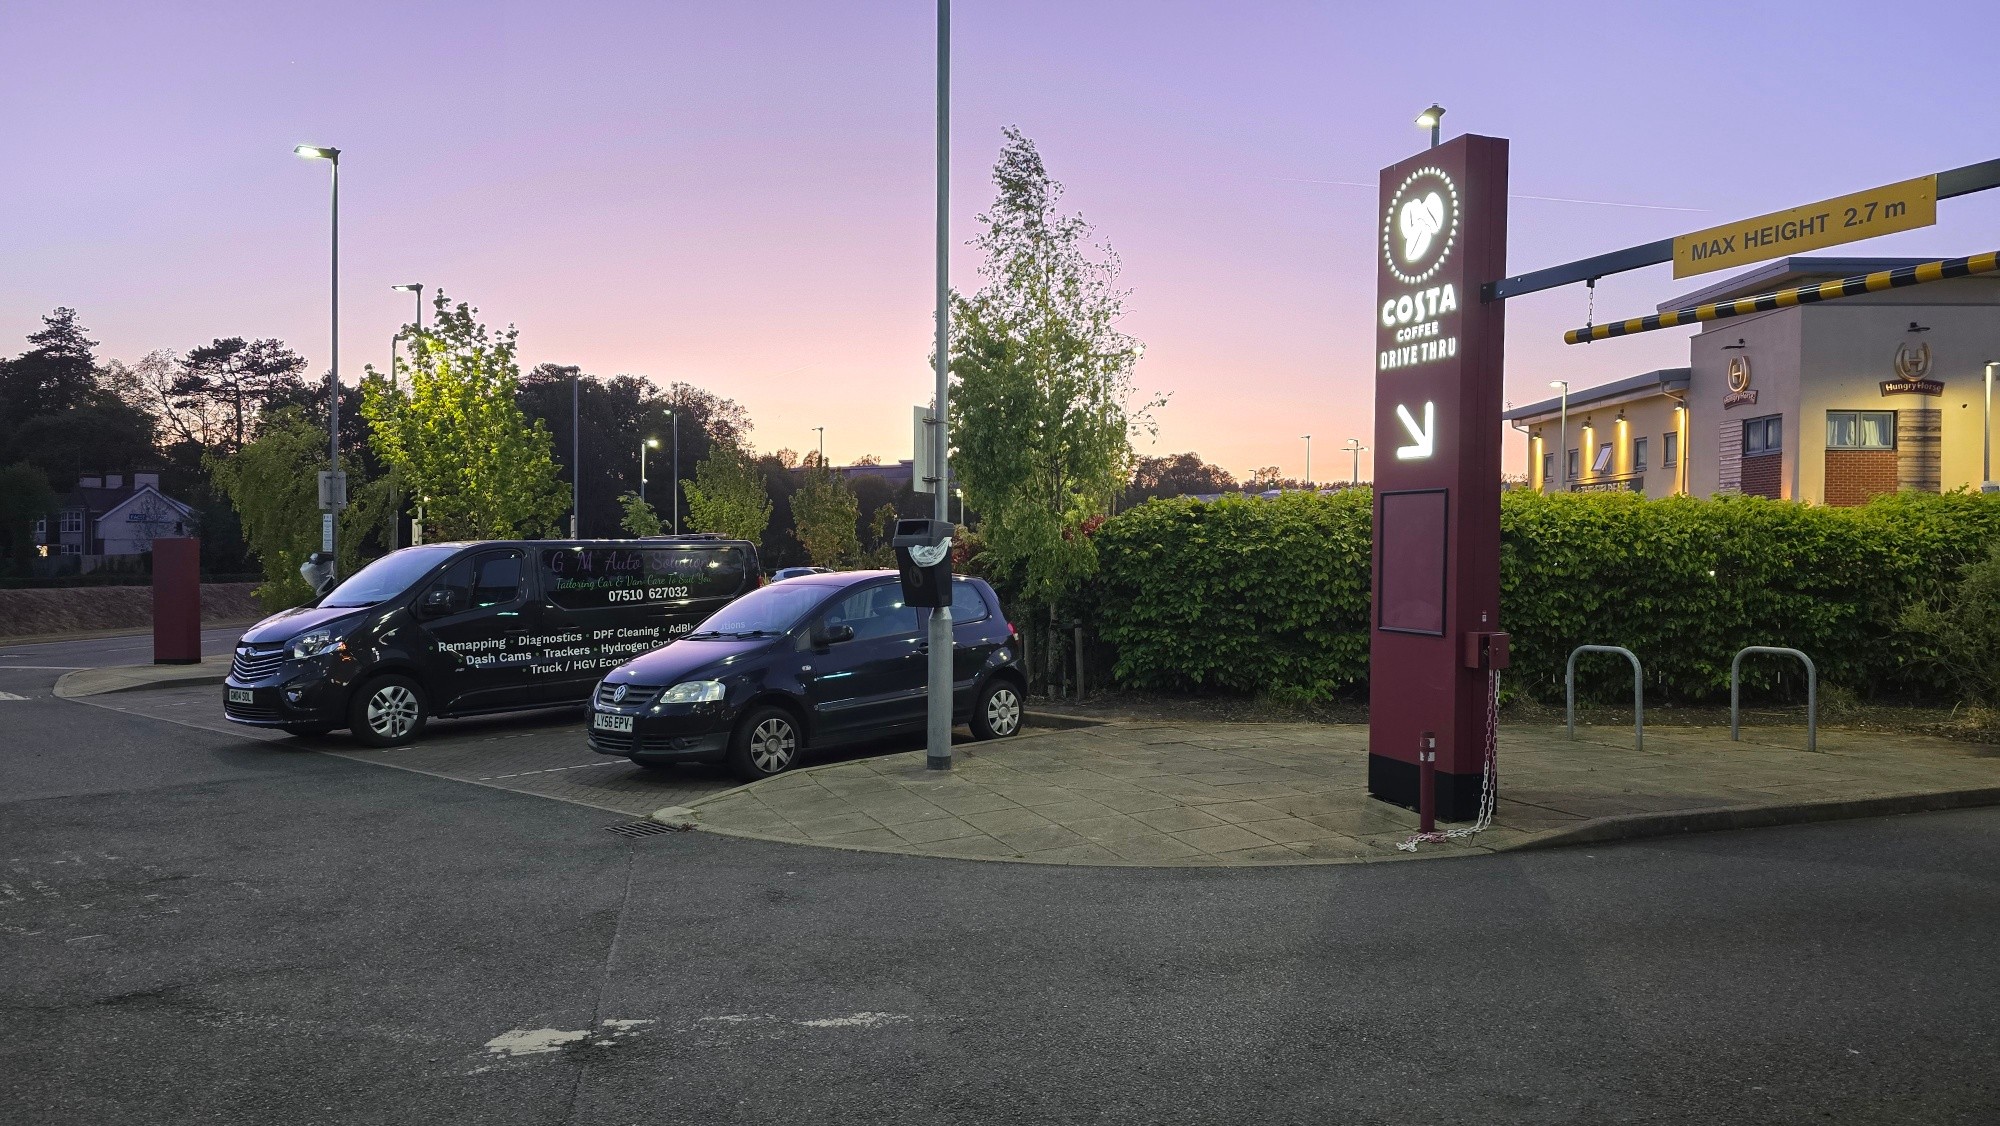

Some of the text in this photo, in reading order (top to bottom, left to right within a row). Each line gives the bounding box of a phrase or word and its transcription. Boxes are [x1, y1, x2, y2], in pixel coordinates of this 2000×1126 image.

[1691, 200, 1906, 262] MAX HEIGHT 2.7 m
[1382, 283, 1457, 328] COSTA
[1396, 321, 1439, 343] COFFEE
[1380, 336, 1457, 370] DRIVE THRU
[552, 551, 564, 573] G
[577, 551, 593, 572] M
[605, 551, 643, 572] Auto
[556, 577, 595, 591] Tailoring
[597, 576, 613, 588] Car
[626, 575, 644, 587] Van
[608, 586, 688, 602] 07510 627032
[438, 637, 507, 652] Remapping
[518, 631, 582, 647] Diagnostics
[593, 628, 615, 640] DPF
[617, 626, 660, 639] Cleaning
[465, 653, 496, 666] Dash
[499, 651, 532, 662] Cams
[543, 645, 590, 659] Trackers
[601, 641, 650, 654] Hydrogen
[530, 661, 563, 675] Truck
[564, 660, 571, 672] /
[573, 659, 597, 671] HGV
[596, 714, 630, 729] LY56 EPV
